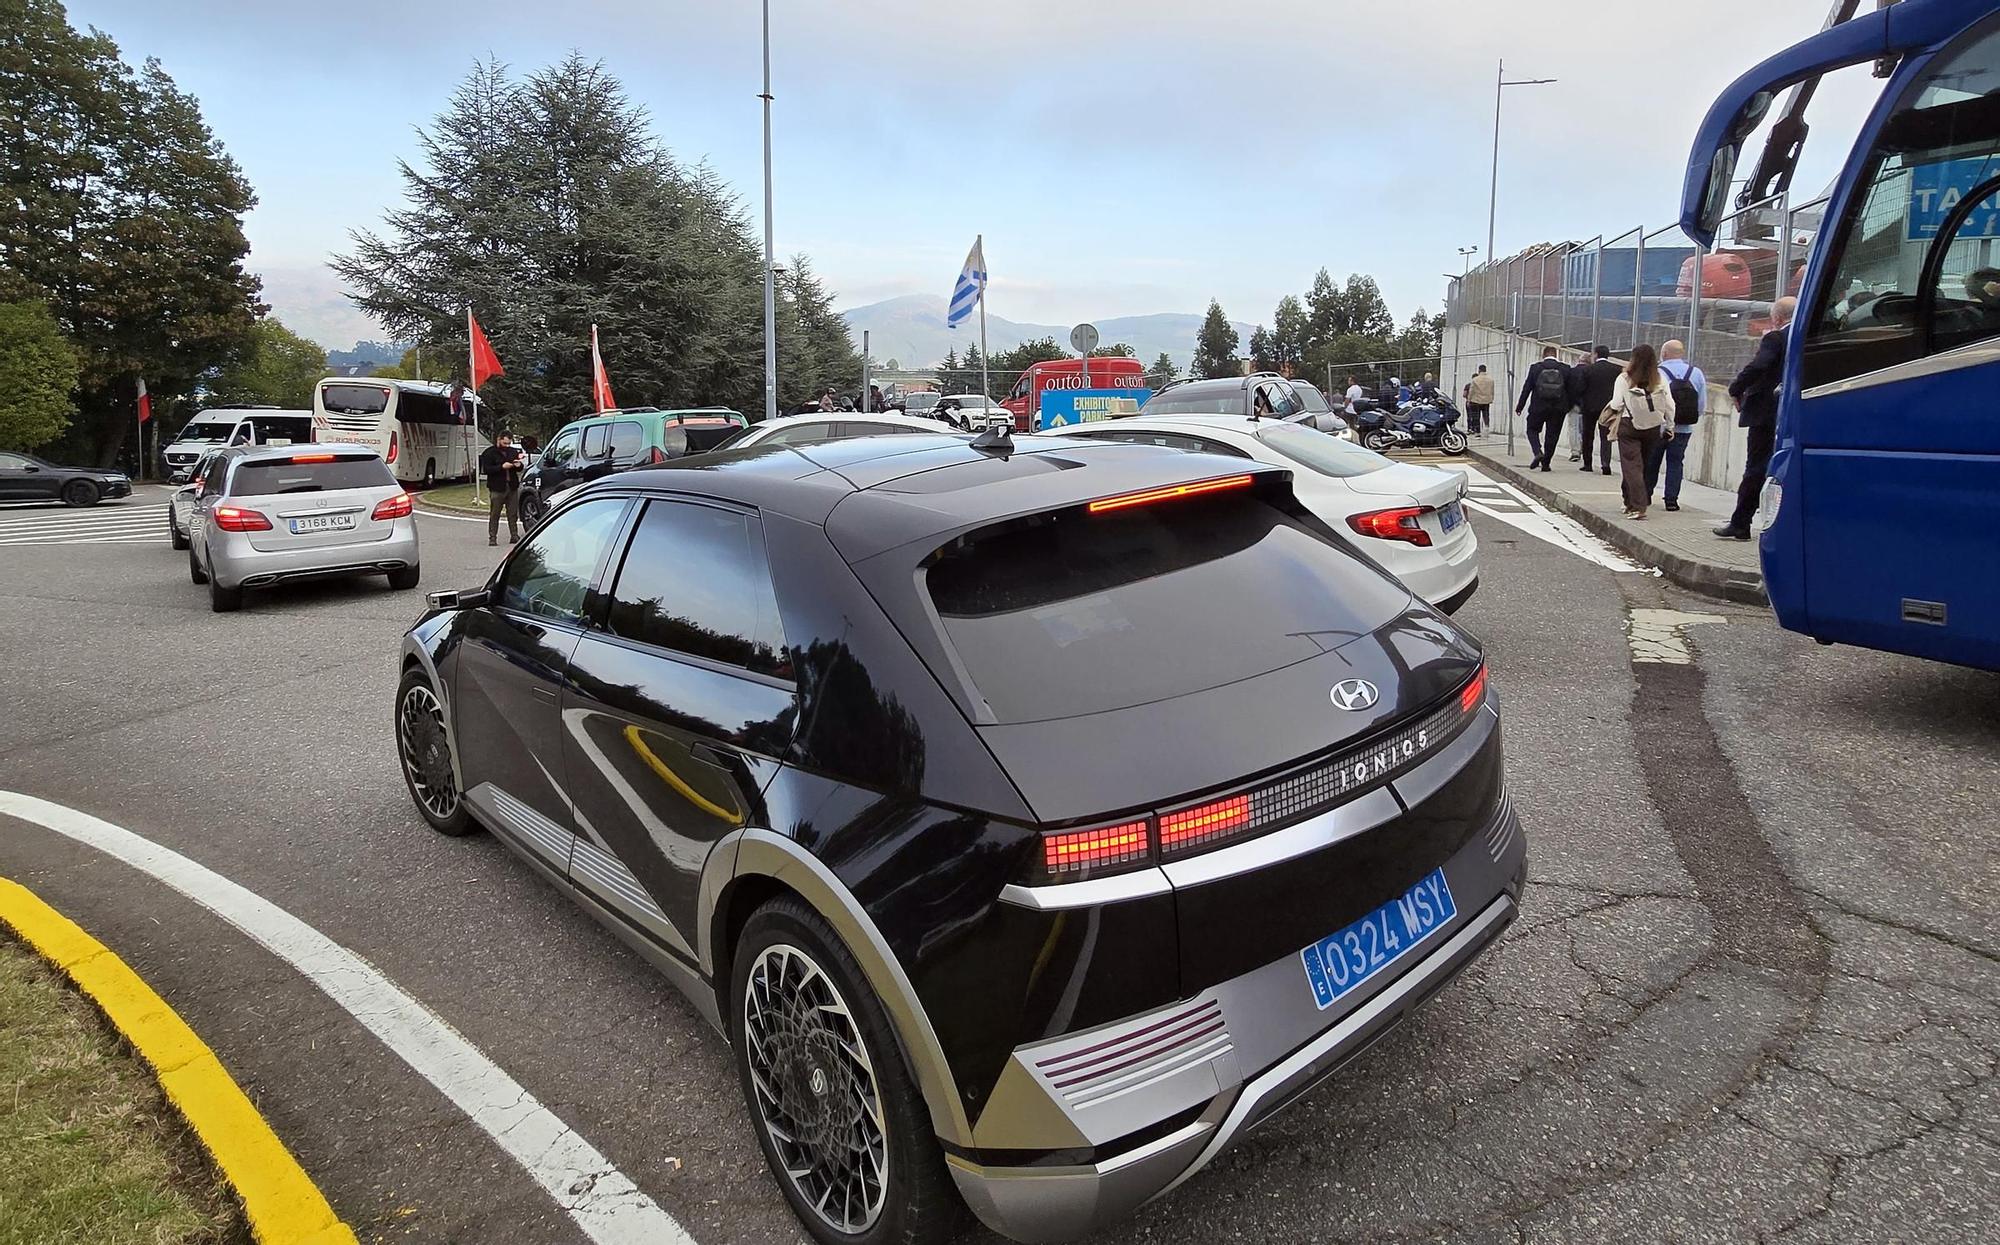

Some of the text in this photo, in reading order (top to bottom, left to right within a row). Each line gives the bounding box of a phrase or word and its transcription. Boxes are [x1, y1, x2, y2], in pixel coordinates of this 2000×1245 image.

[1046, 373, 1092, 391] outón
[1114, 376, 1144, 388] outón
[1074, 396, 1121, 410] EXHIBITO
[1080, 410, 1109, 422] PARKI
[299, 516, 352, 529] 3168 KCM
[1341, 729, 1427, 788] IONIQ 5
[1326, 875, 1445, 986] 0324 MSY
[1317, 981, 1326, 996] E
